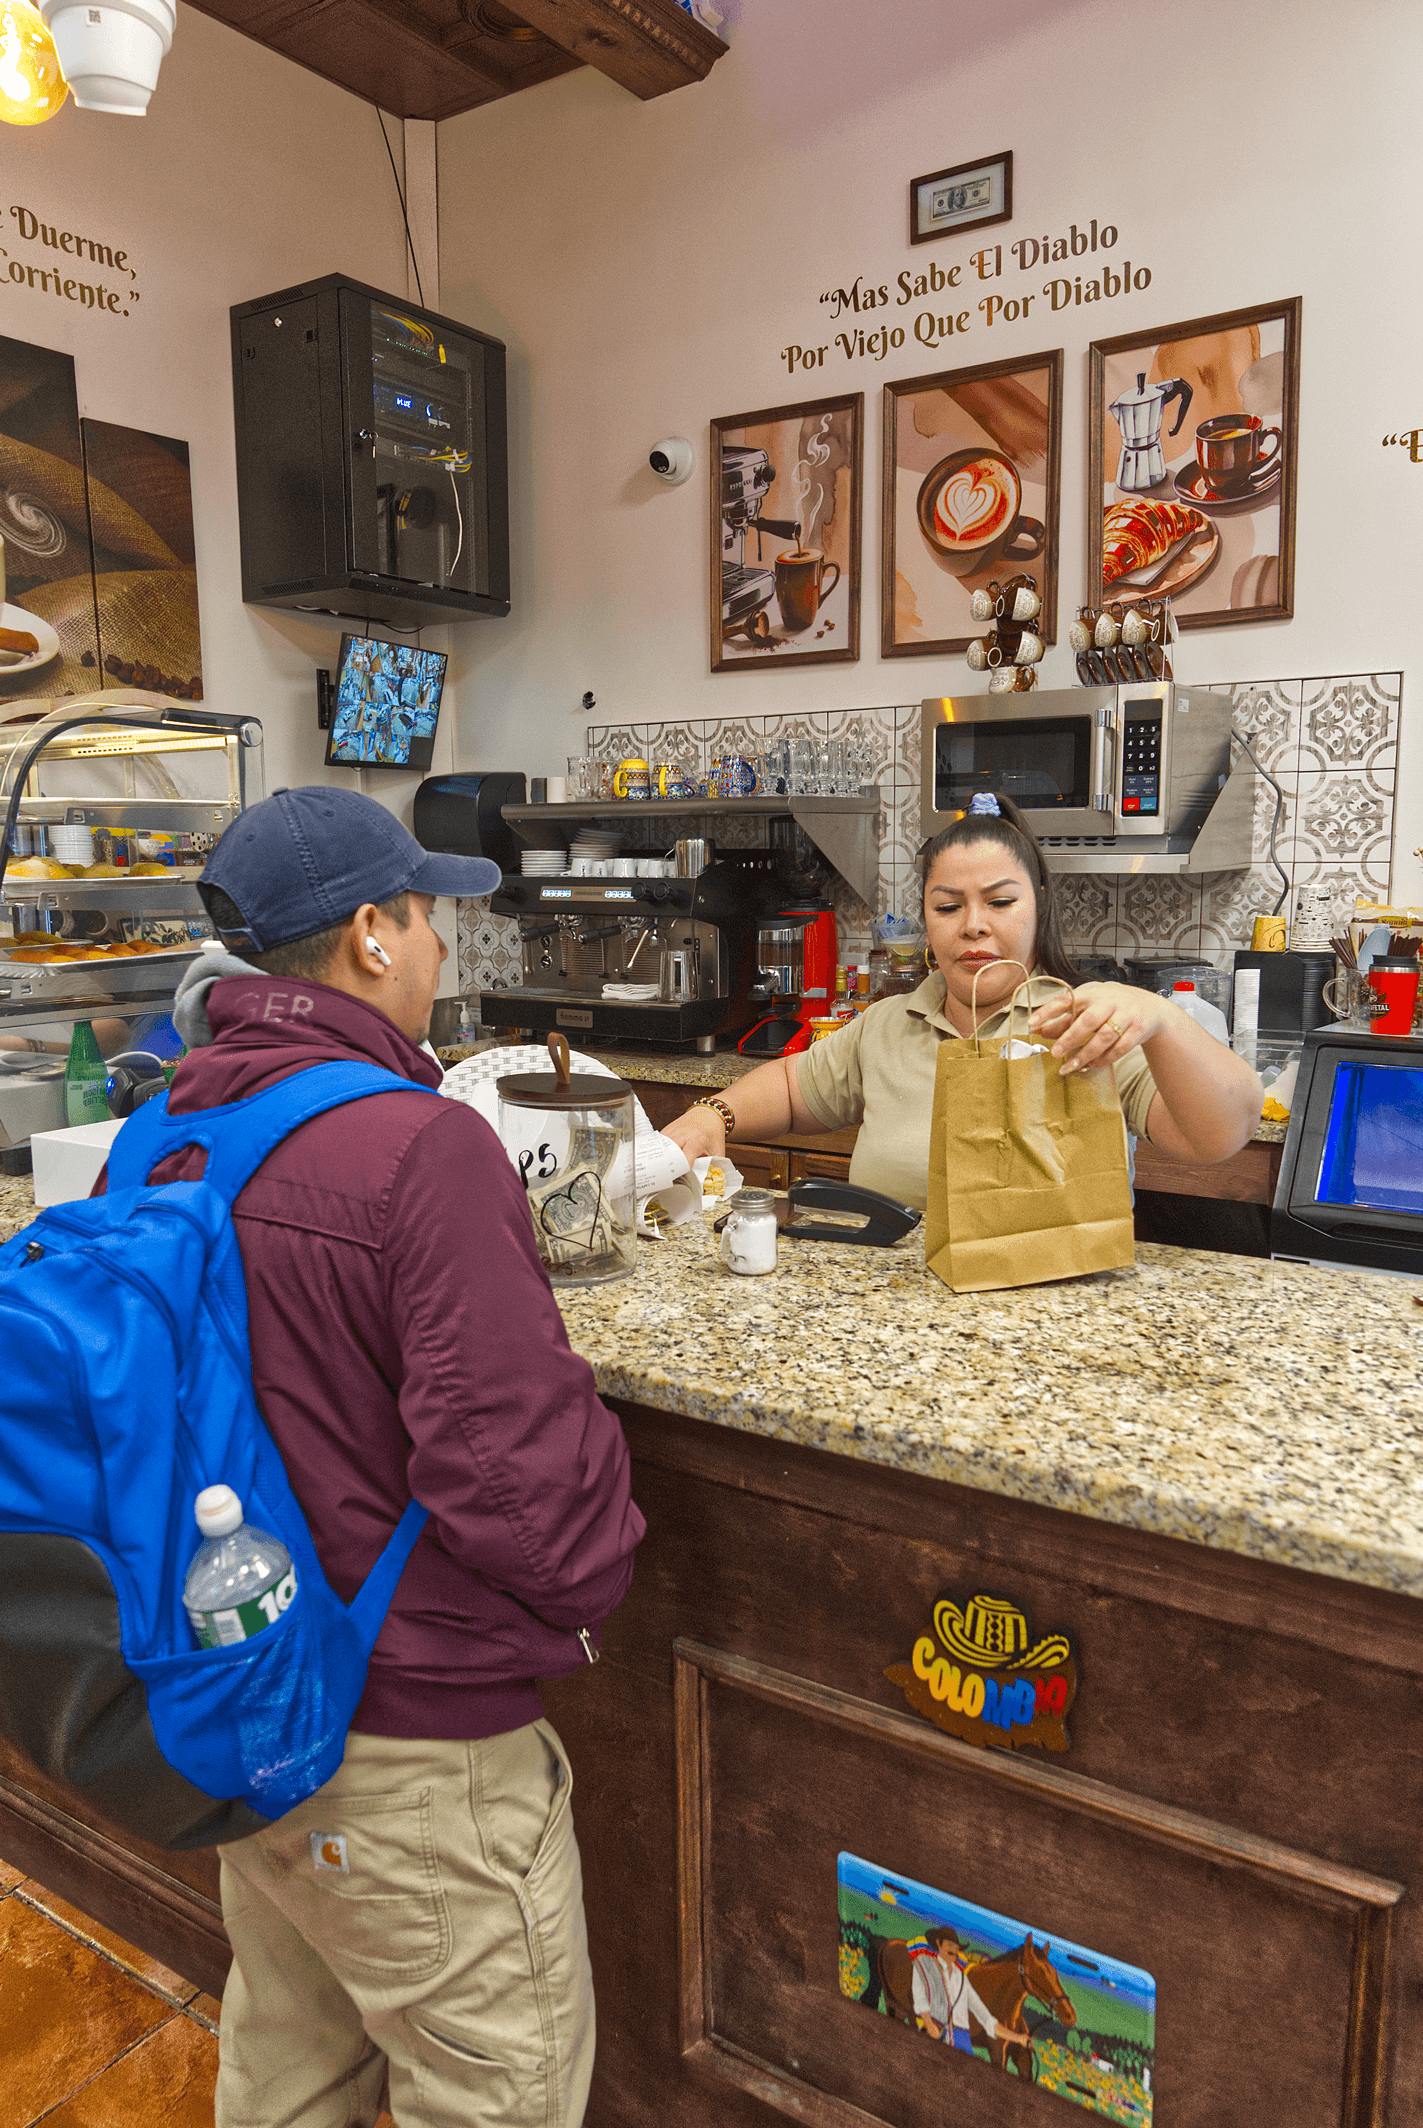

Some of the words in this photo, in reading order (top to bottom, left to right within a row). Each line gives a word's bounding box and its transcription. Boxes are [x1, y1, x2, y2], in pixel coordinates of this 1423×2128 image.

[10, 206, 136, 280] Duerme,
[819, 276, 889, 319] “Mas
[896, 262, 962, 306] Sabe
[969, 245, 1002, 280] El
[1011, 219, 1118, 270] Diablo
[781, 344, 828, 373] Por
[834, 325, 905, 361] Viejo
[913, 311, 971, 348] Que
[978, 295, 1035, 326] Por
[1043, 261, 1151, 311] Diablo
[518, 1143, 557, 1190] PS
[257, 1563, 298, 1624] 10
[912, 1636, 1068, 1730] COLOMBIA
